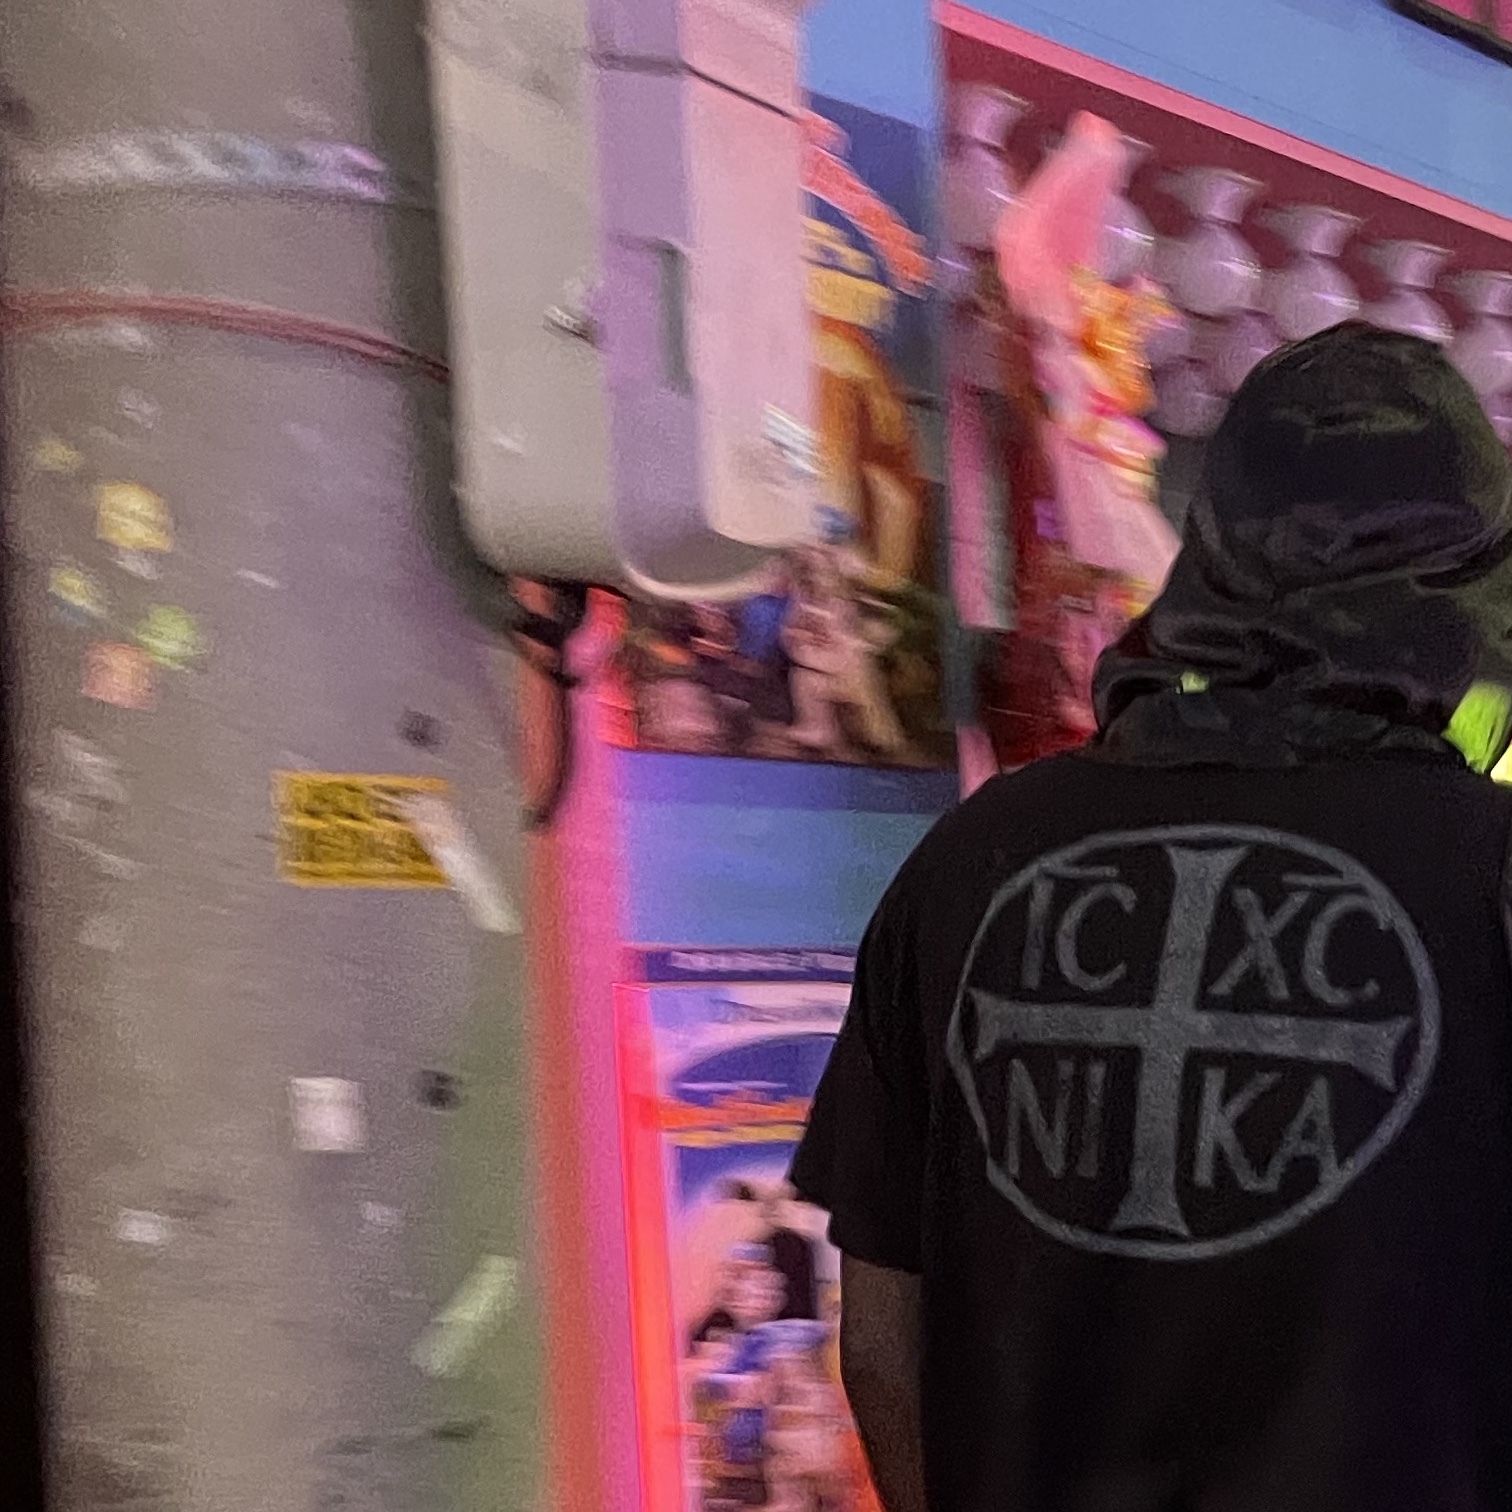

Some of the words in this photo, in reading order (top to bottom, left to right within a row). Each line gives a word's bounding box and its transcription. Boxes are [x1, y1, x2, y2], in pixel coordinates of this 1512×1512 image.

[1020, 872, 1138, 991] IC
[1207, 888, 1397, 1006] XC
[1007, 1058, 1106, 1179] NI
[1194, 1066, 1347, 1193] KA
